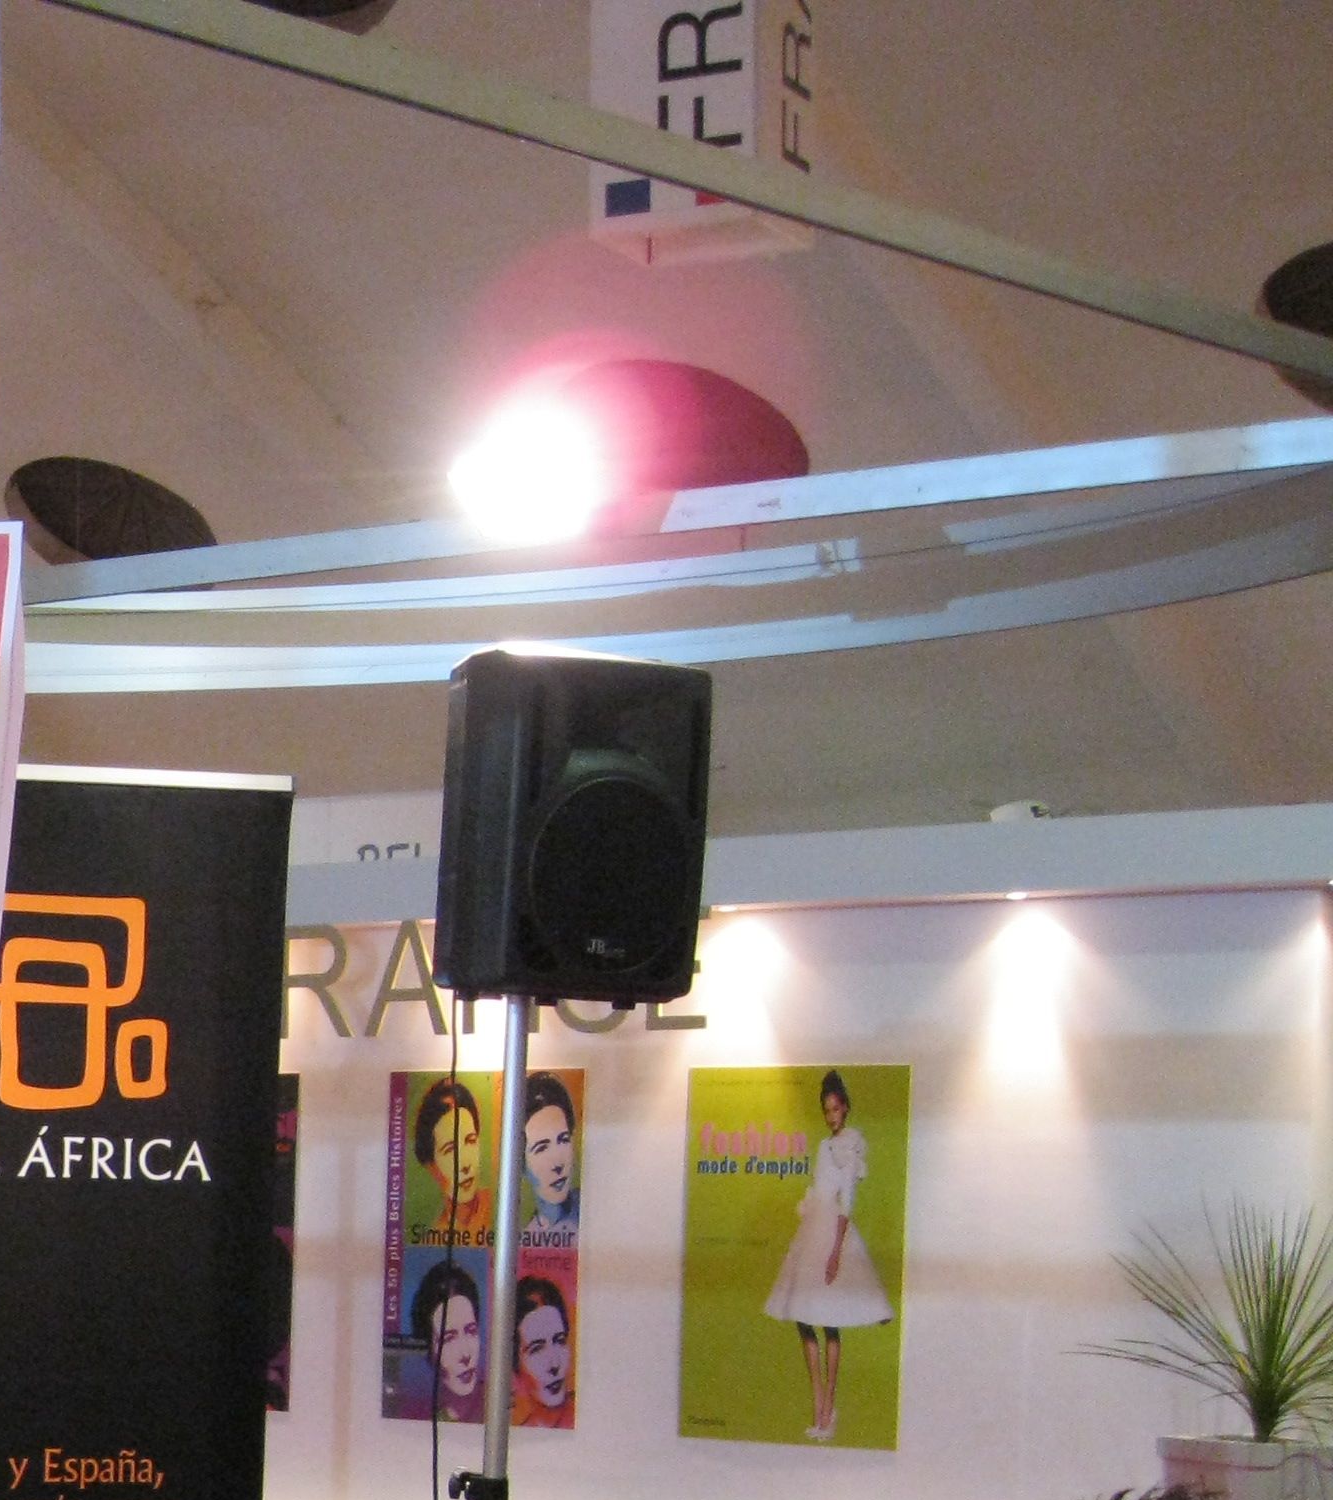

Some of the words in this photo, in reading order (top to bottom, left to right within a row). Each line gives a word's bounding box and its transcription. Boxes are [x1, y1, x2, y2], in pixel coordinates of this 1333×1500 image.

[391, 1097, 403, 1168] Histoires
[699, 1121, 808, 1157] fashion
[17, 1125, 212, 1182] ÁFRICA
[697, 1156, 738, 1174] mode
[745, 1156, 810, 1180] d'emploi
[389, 1174, 400, 1221] Belles
[389, 1227, 403, 1261] plus
[411, 1223, 471, 1246] Simone
[477, 1222, 495, 1246] de
[519, 1226, 576, 1248] auvoir
[387, 1289, 398, 1321] Les
[8, 1457, 29, 1490] y
[43, 1447, 165, 1490] España,
